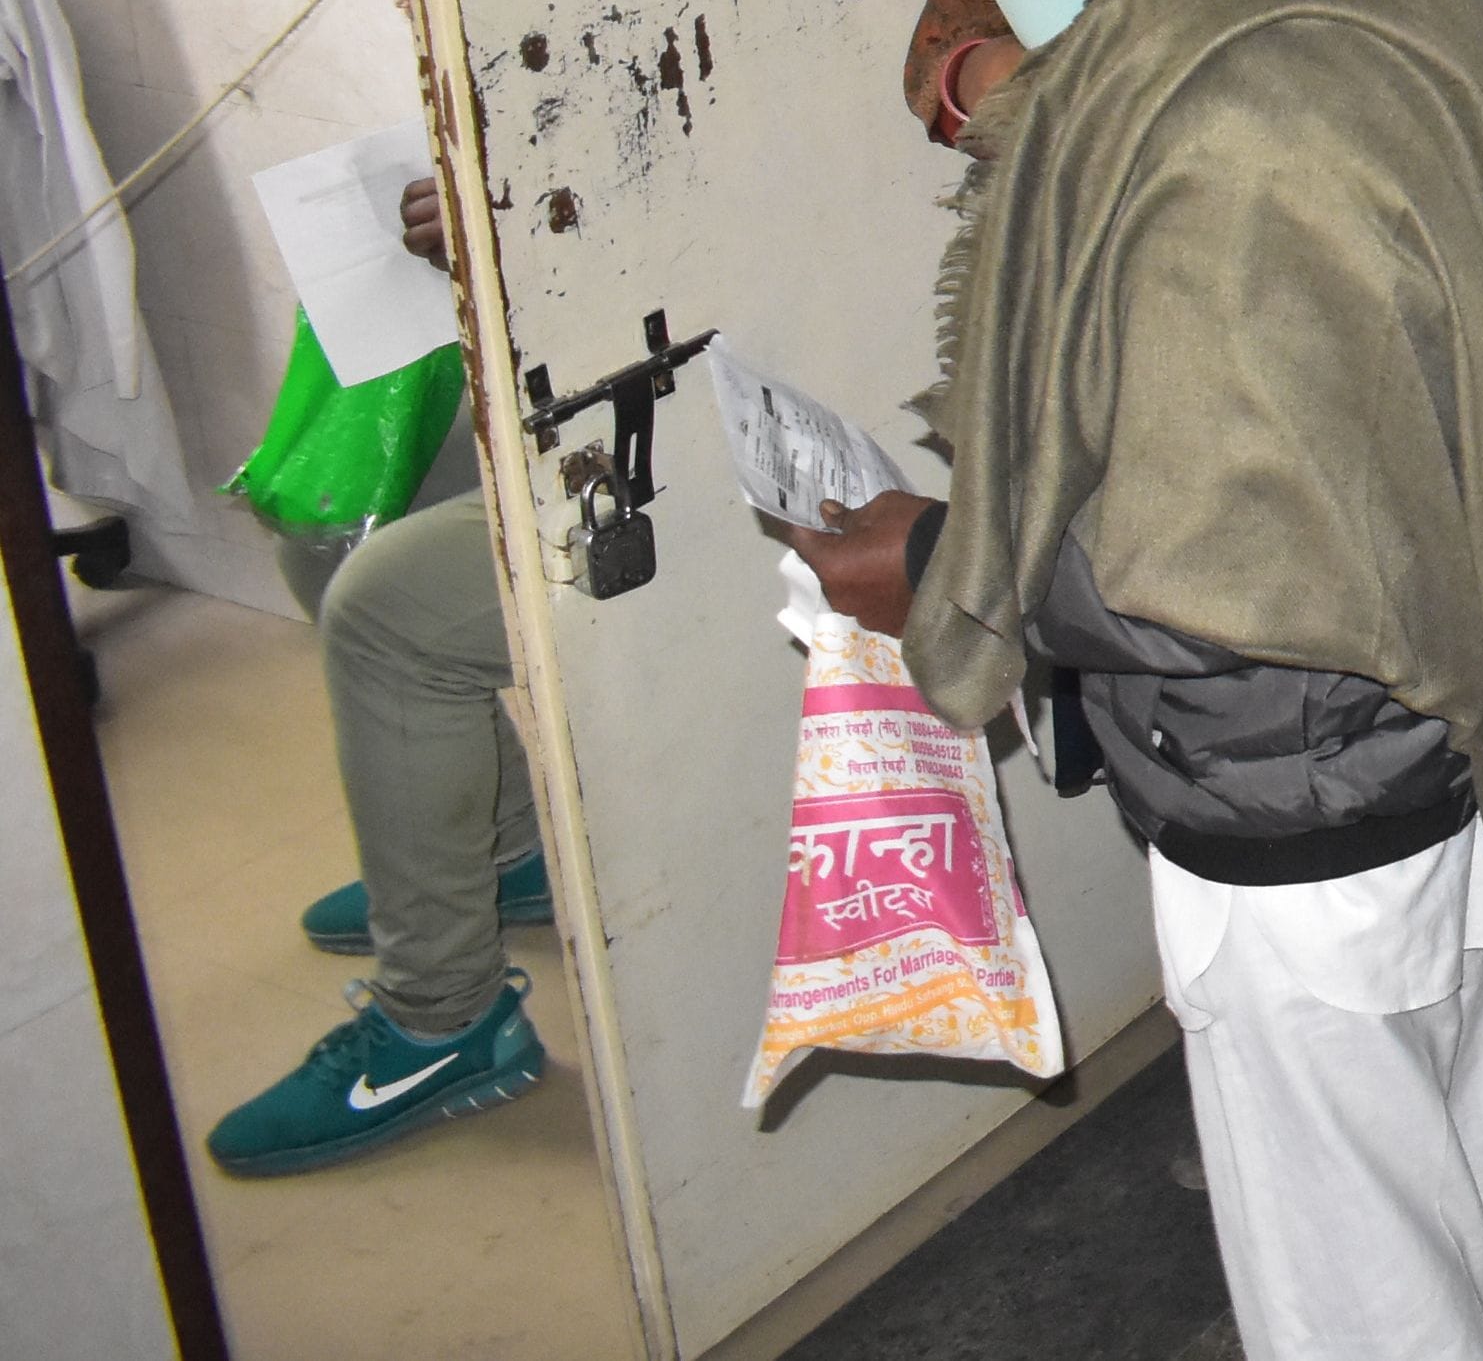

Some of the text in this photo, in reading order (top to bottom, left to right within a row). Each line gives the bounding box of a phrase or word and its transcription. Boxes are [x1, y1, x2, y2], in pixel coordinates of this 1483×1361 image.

[787, 813, 957, 887] कान्हा
[816, 879, 934, 930] स्वीट्स
[873, 966, 898, 985] For
